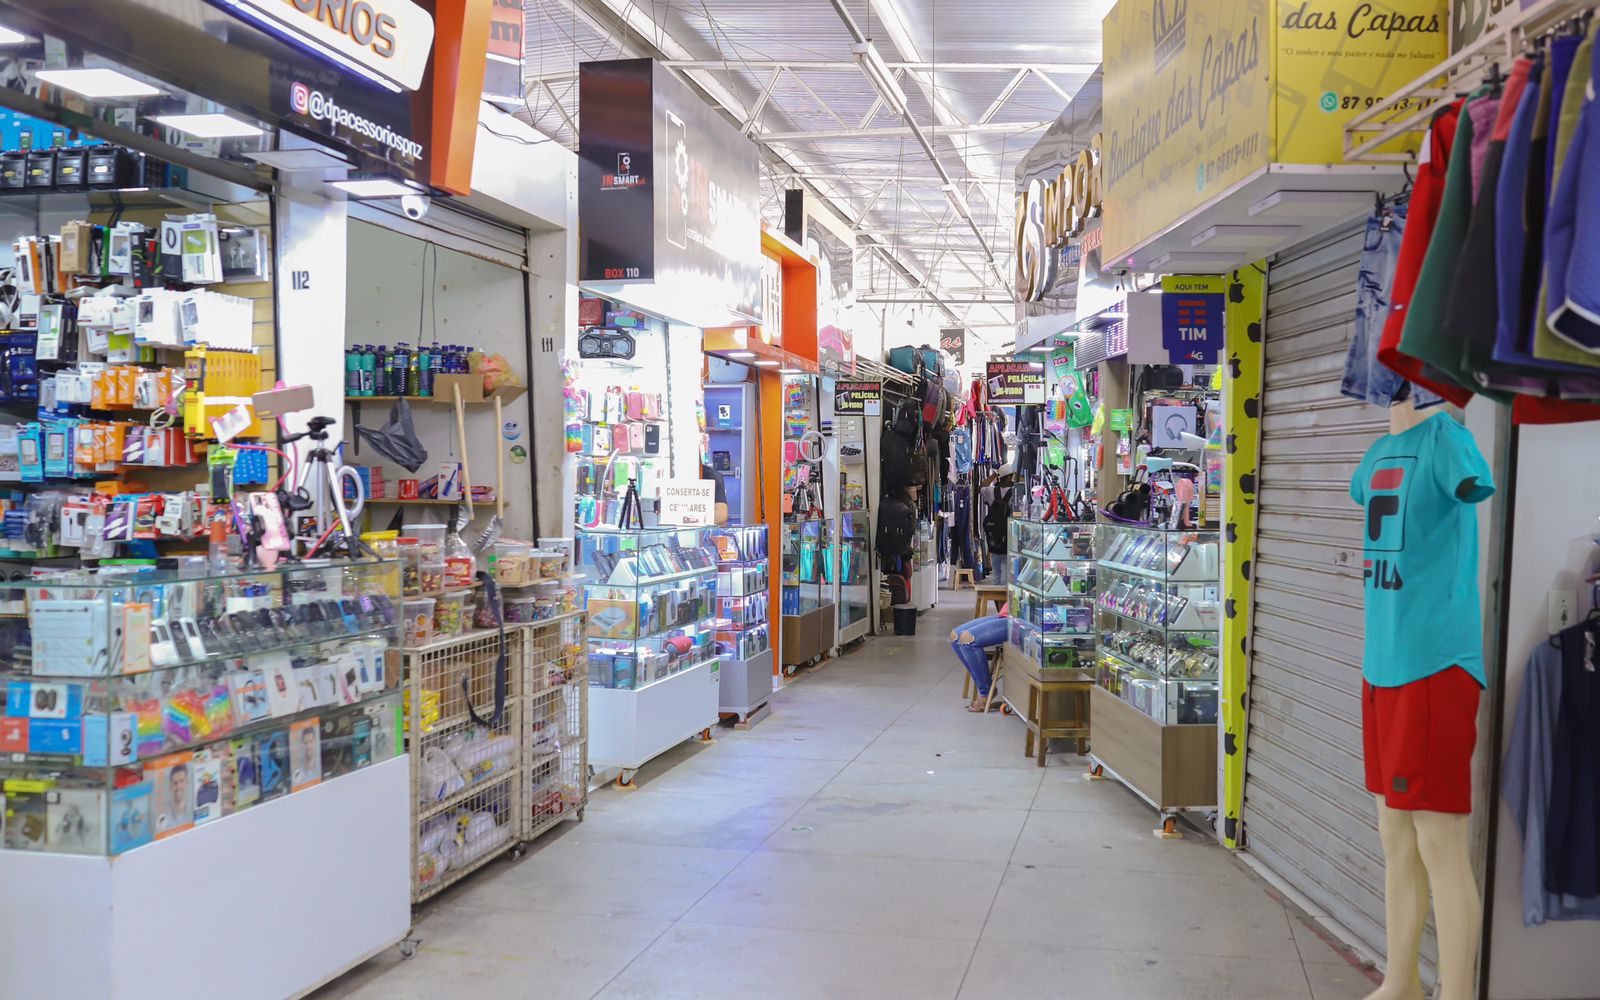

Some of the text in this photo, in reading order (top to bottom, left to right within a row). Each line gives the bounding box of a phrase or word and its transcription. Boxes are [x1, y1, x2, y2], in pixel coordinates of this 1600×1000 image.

[1282, 2, 1440, 40] das Capas
[291, 0, 397, 58] RIOS
[1108, 107, 1161, 192] Boutique
[1164, 69, 1192, 142] das
[1198, 16, 1258, 130] Capas
[1341, 96, 1360, 110] 87
[309, 91, 423, 160] @dpacessoriospnz
[605, 267, 640, 278] BOX 110
[291, 270, 310, 290] 112
[1178, 327, 1207, 341] TIM
[541, 337, 553, 353] 111
[989, 363, 1043, 373] APLICAM
[1007, 373, 1043, 383] PELÍCULA
[851, 391, 880, 399] PELÍCULA
[666, 487, 710, 497] CONSERTA-SE
[669, 503, 707, 513] CEARES
[1363, 559, 1404, 591] FILA
